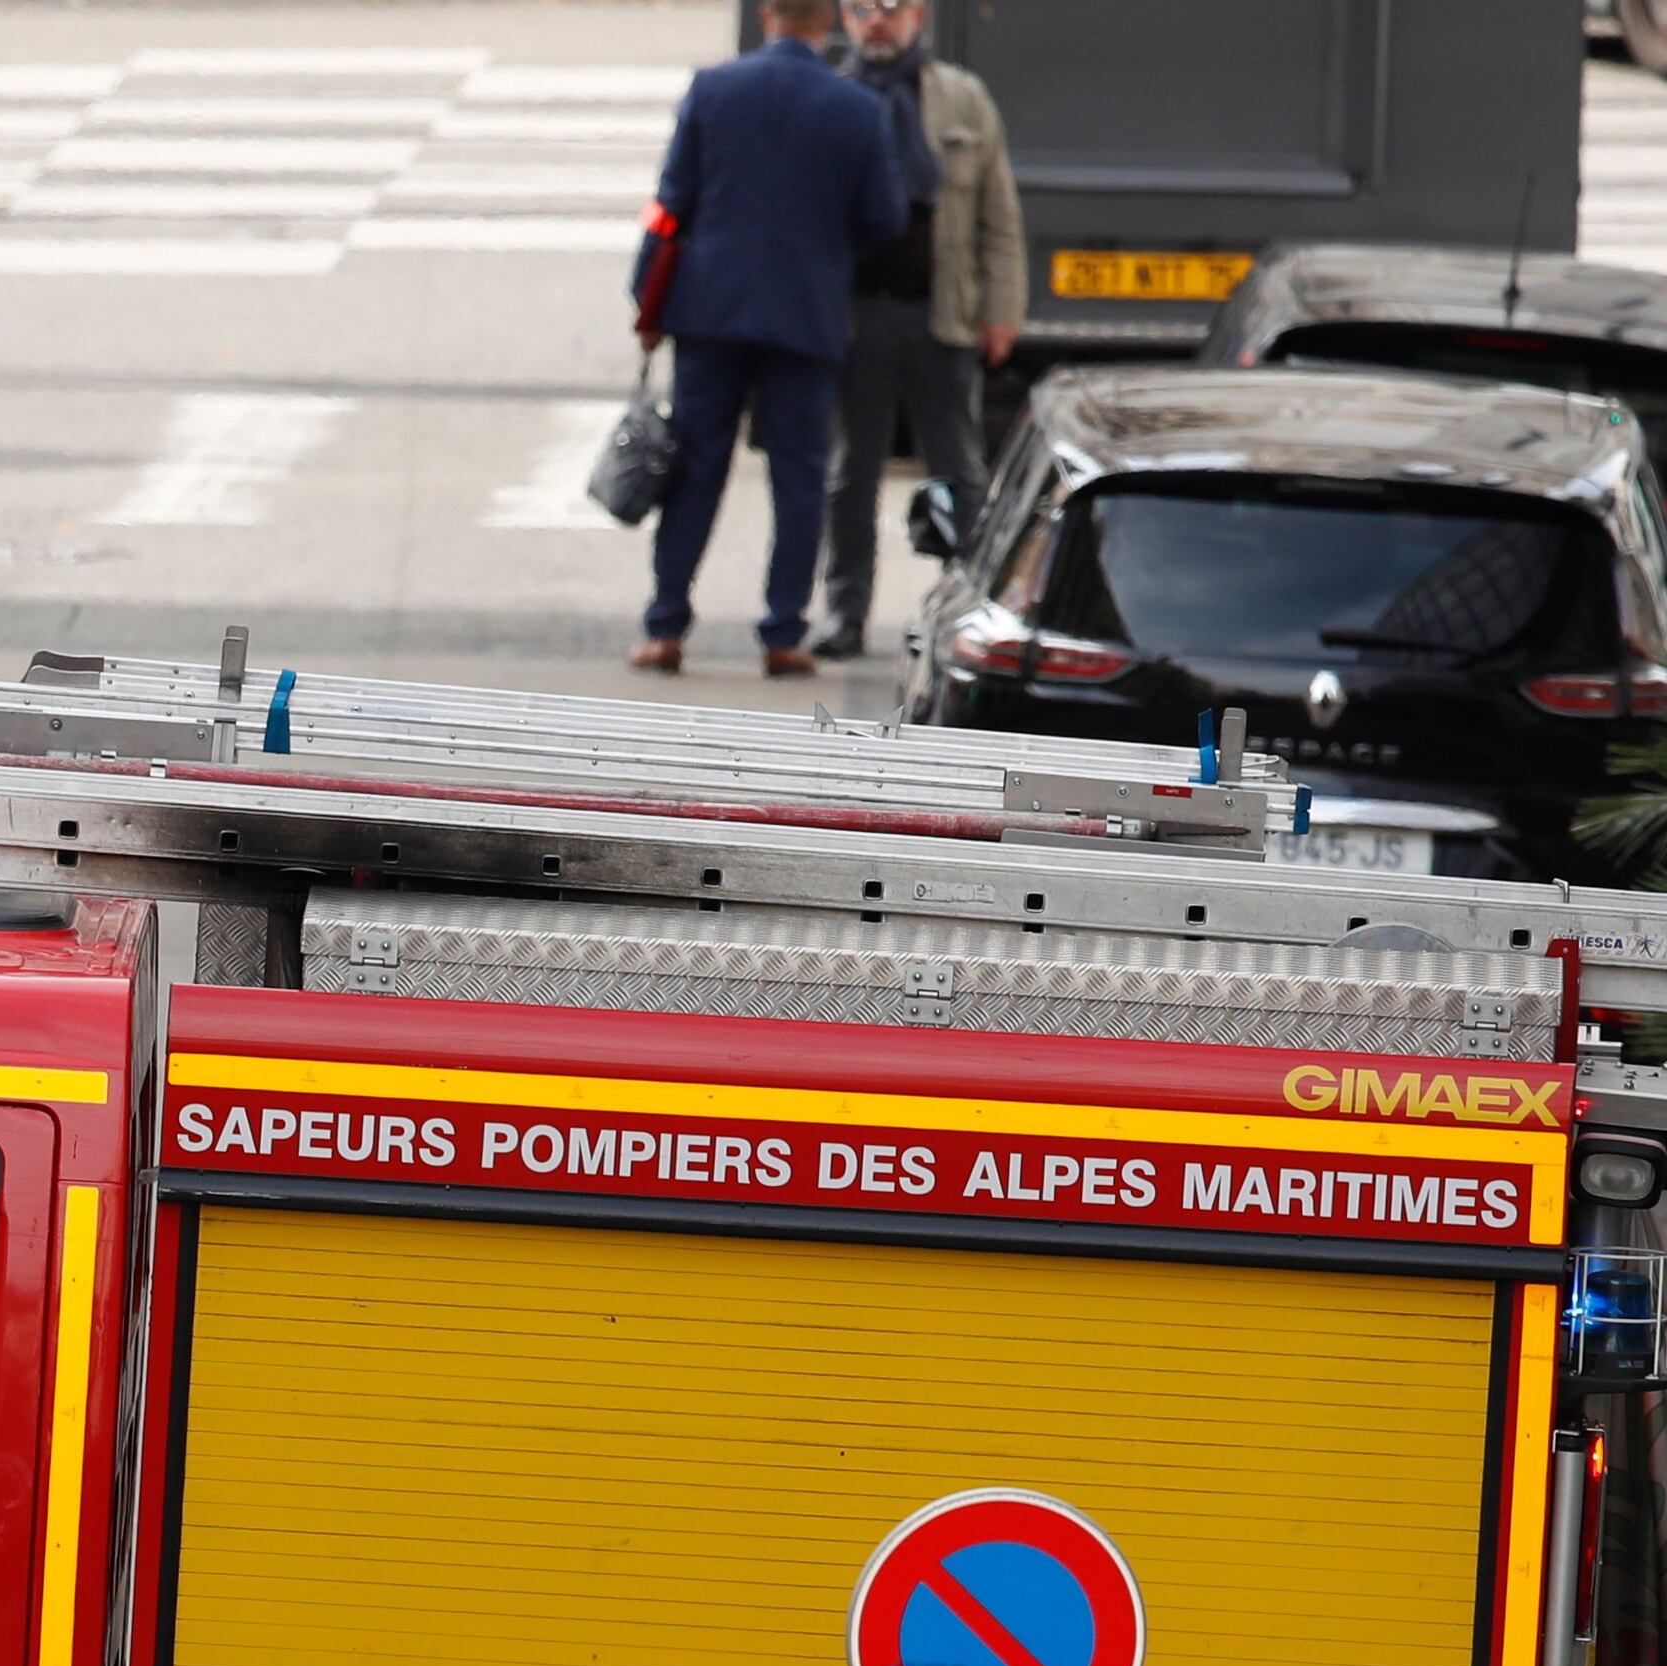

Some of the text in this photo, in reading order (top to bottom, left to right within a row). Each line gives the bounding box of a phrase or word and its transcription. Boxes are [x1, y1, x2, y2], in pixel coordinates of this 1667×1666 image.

[1282, 1064, 1563, 1128] GIMAEX
[177, 1103, 1519, 1229] SAPEURS POMPIERS DES ALPES MARITIMES
